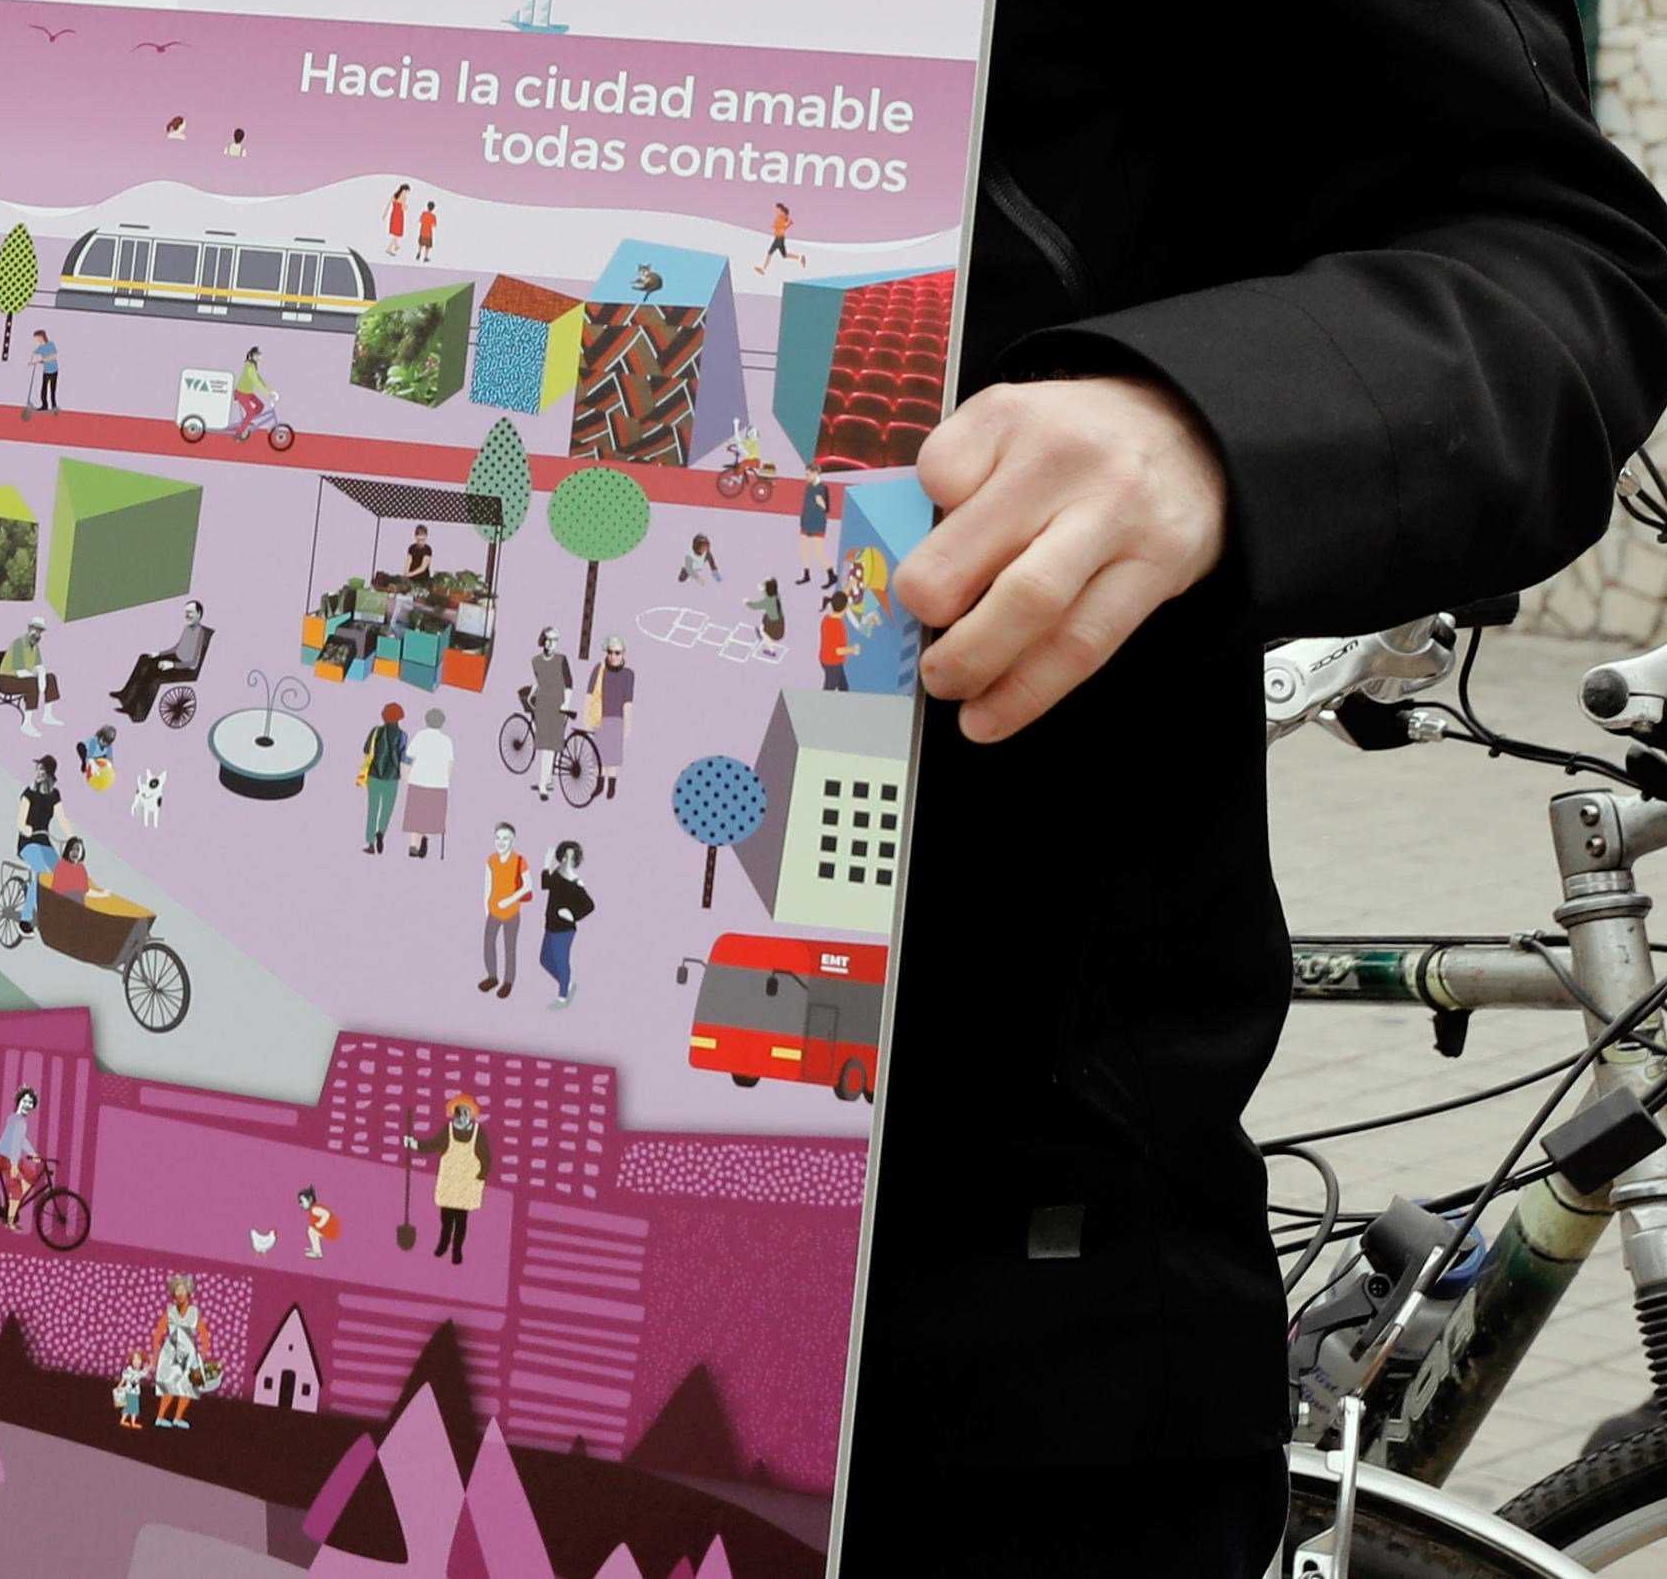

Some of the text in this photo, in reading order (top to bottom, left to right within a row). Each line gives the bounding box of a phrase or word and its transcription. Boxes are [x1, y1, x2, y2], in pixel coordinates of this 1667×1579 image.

[300, 52, 914, 134] Hacia la ciudad amable
[481, 124, 908, 193] todas contamos
[821, 953, 850, 967] EMT
